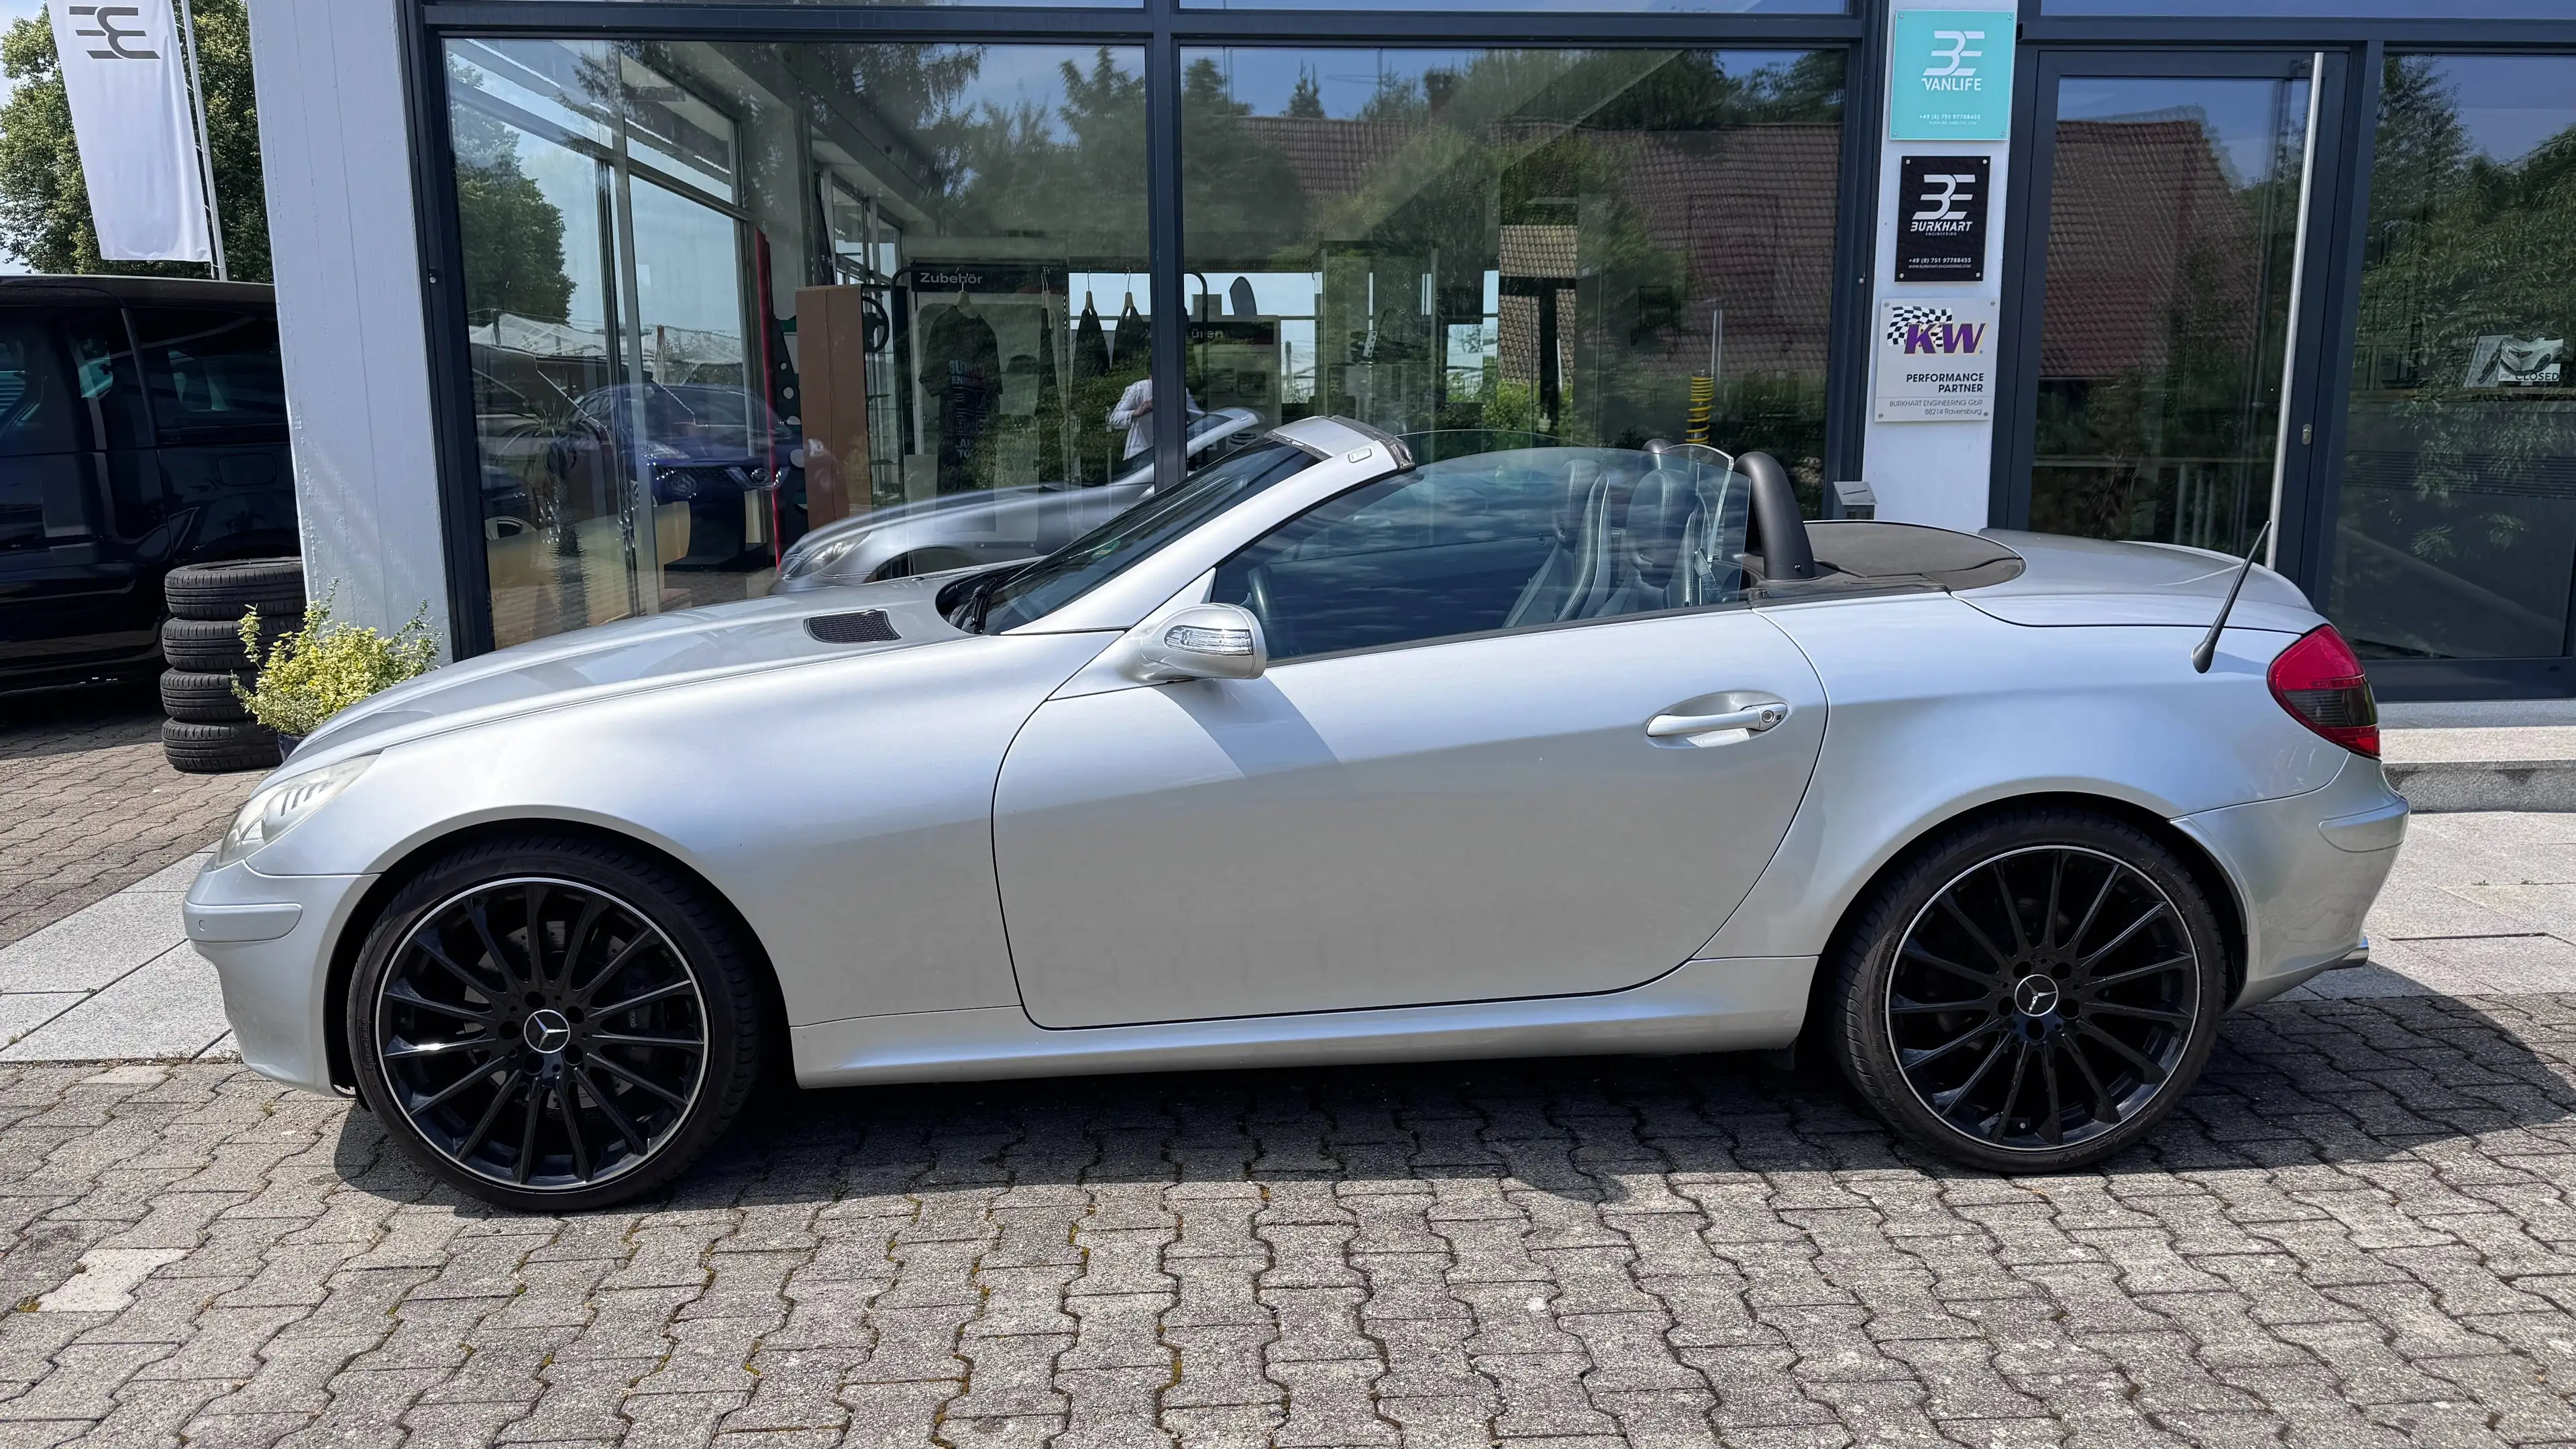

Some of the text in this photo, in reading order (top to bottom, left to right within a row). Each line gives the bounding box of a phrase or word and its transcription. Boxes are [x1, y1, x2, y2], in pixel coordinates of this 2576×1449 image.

[1921, 78, 1982, 91] VANLIFE
[1910, 221, 1973, 231] BURKHART
[920, 272, 983, 284] Zubehör
[1904, 323, 1987, 354] KW
[1906, 373, 1984, 382] PERFORMANCE
[2516, 372, 2559, 381] CLOSED
[1938, 384, 1983, 392] PARTNER
